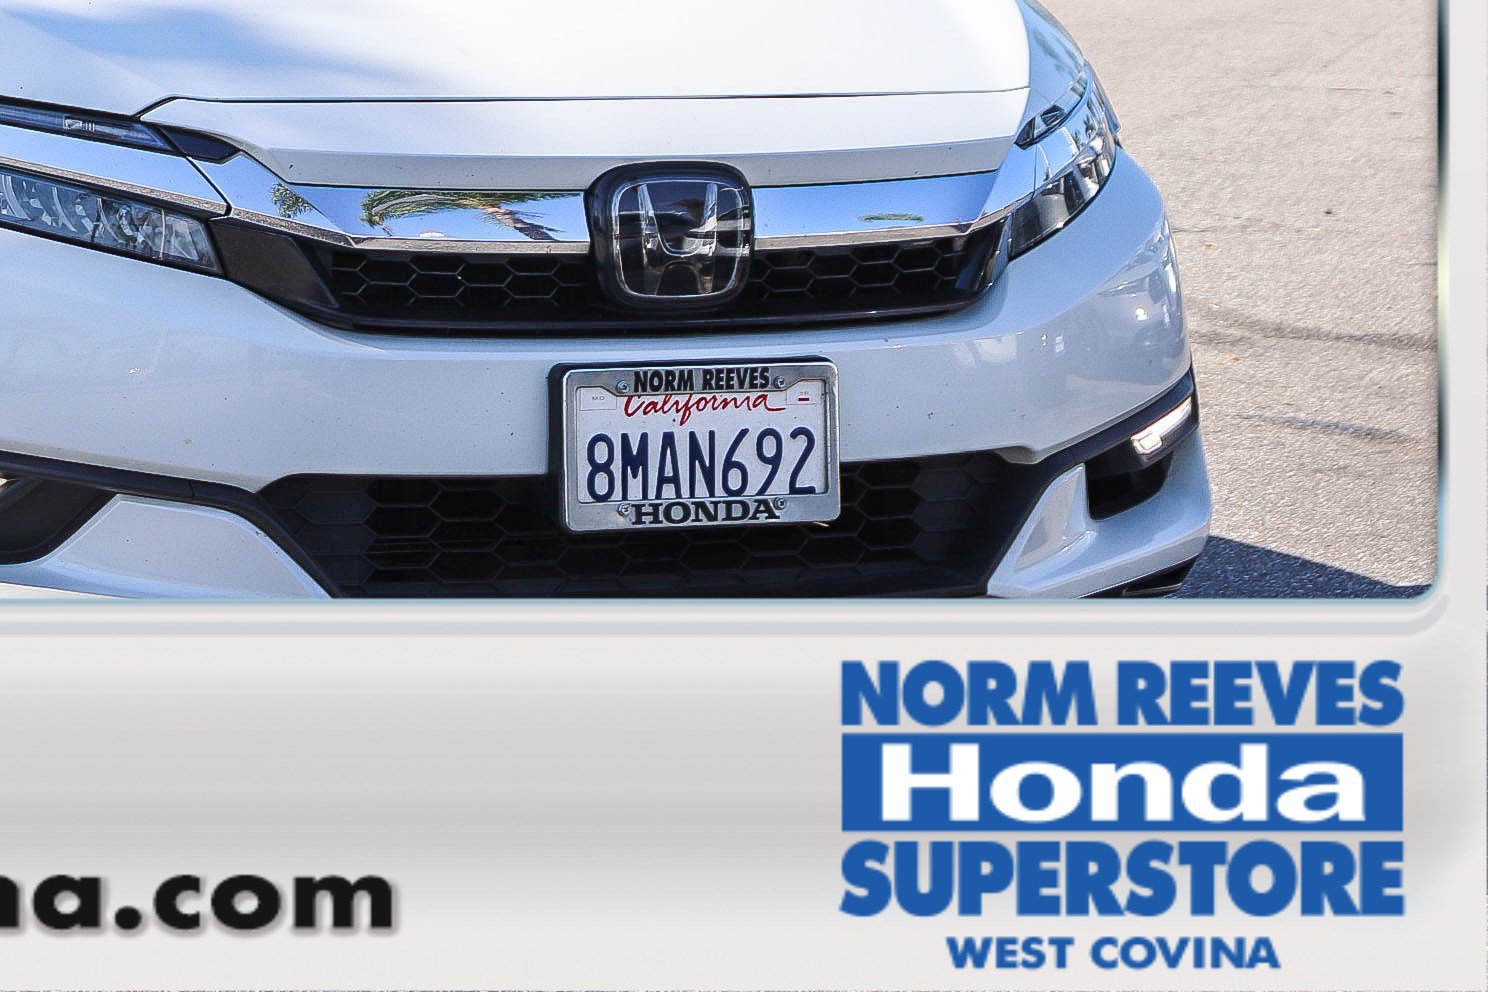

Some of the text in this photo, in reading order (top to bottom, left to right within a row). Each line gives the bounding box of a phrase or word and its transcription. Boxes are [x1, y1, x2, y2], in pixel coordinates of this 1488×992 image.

[633, 367, 770, 393] NORM REEVES
[623, 394, 786, 426] California
[587, 427, 816, 502] 8MAN692
[631, 500, 779, 525] HONDA
